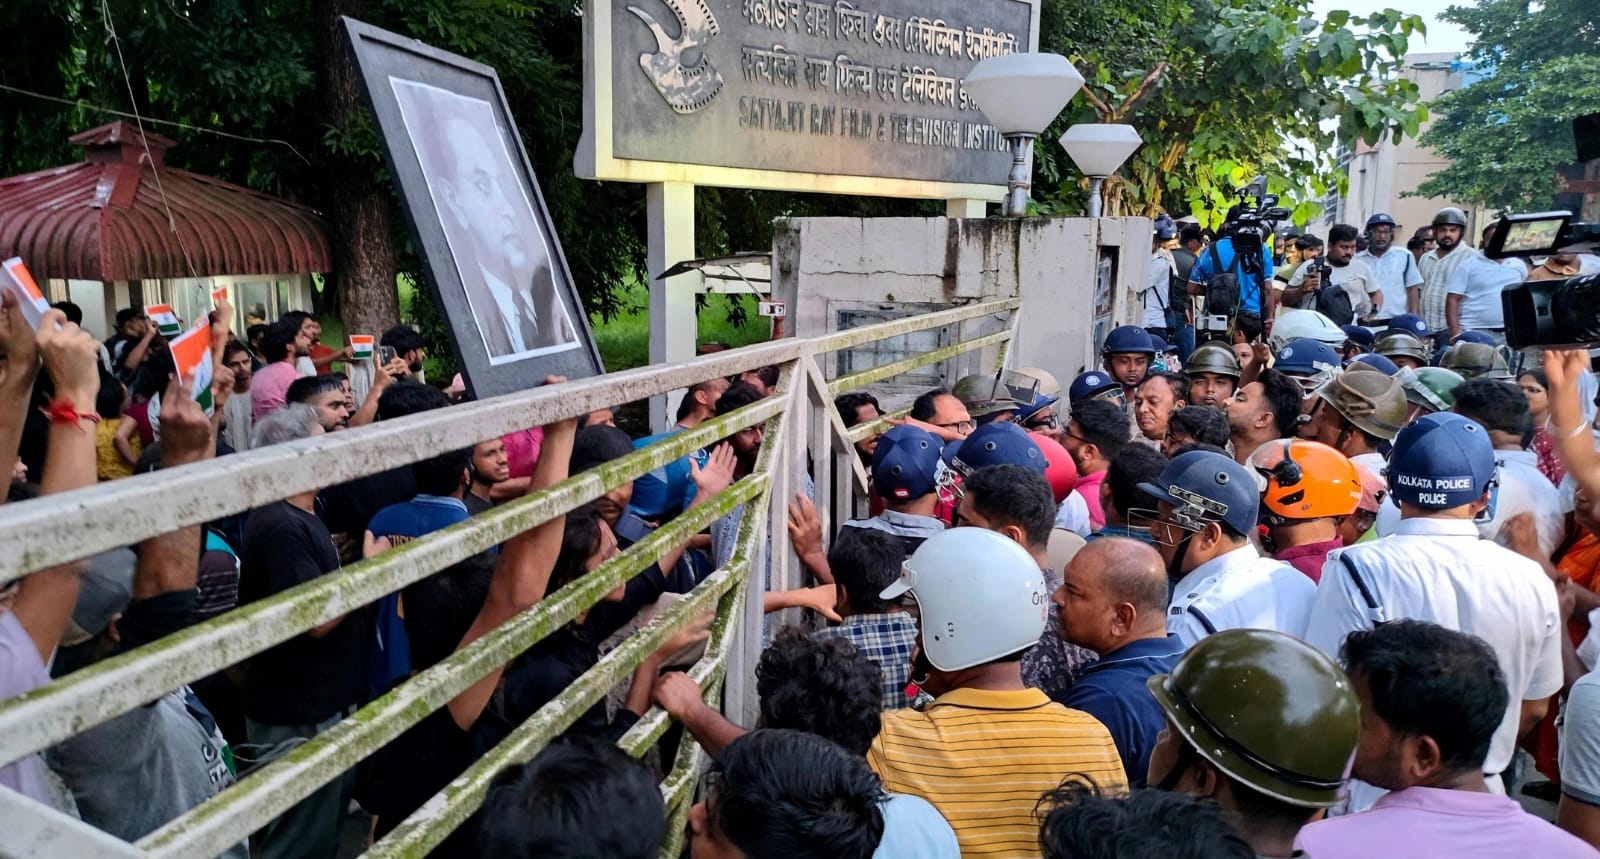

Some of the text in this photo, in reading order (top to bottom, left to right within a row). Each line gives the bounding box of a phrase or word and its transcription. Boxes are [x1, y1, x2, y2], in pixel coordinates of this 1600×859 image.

[804, 58, 831, 91] राय
[835, 54, 873, 97] फिल्म
[739, 95, 806, 133] SATYAJIT
[810, 103, 836, 136] RAY
[840, 107, 873, 139] FILM
[877, 112, 887, 142] &
[890, 112, 960, 148] TELEVISION
[1397, 474, 1471, 490] KOLKATA POLICE
[1418, 492, 1448, 505] POLICE
